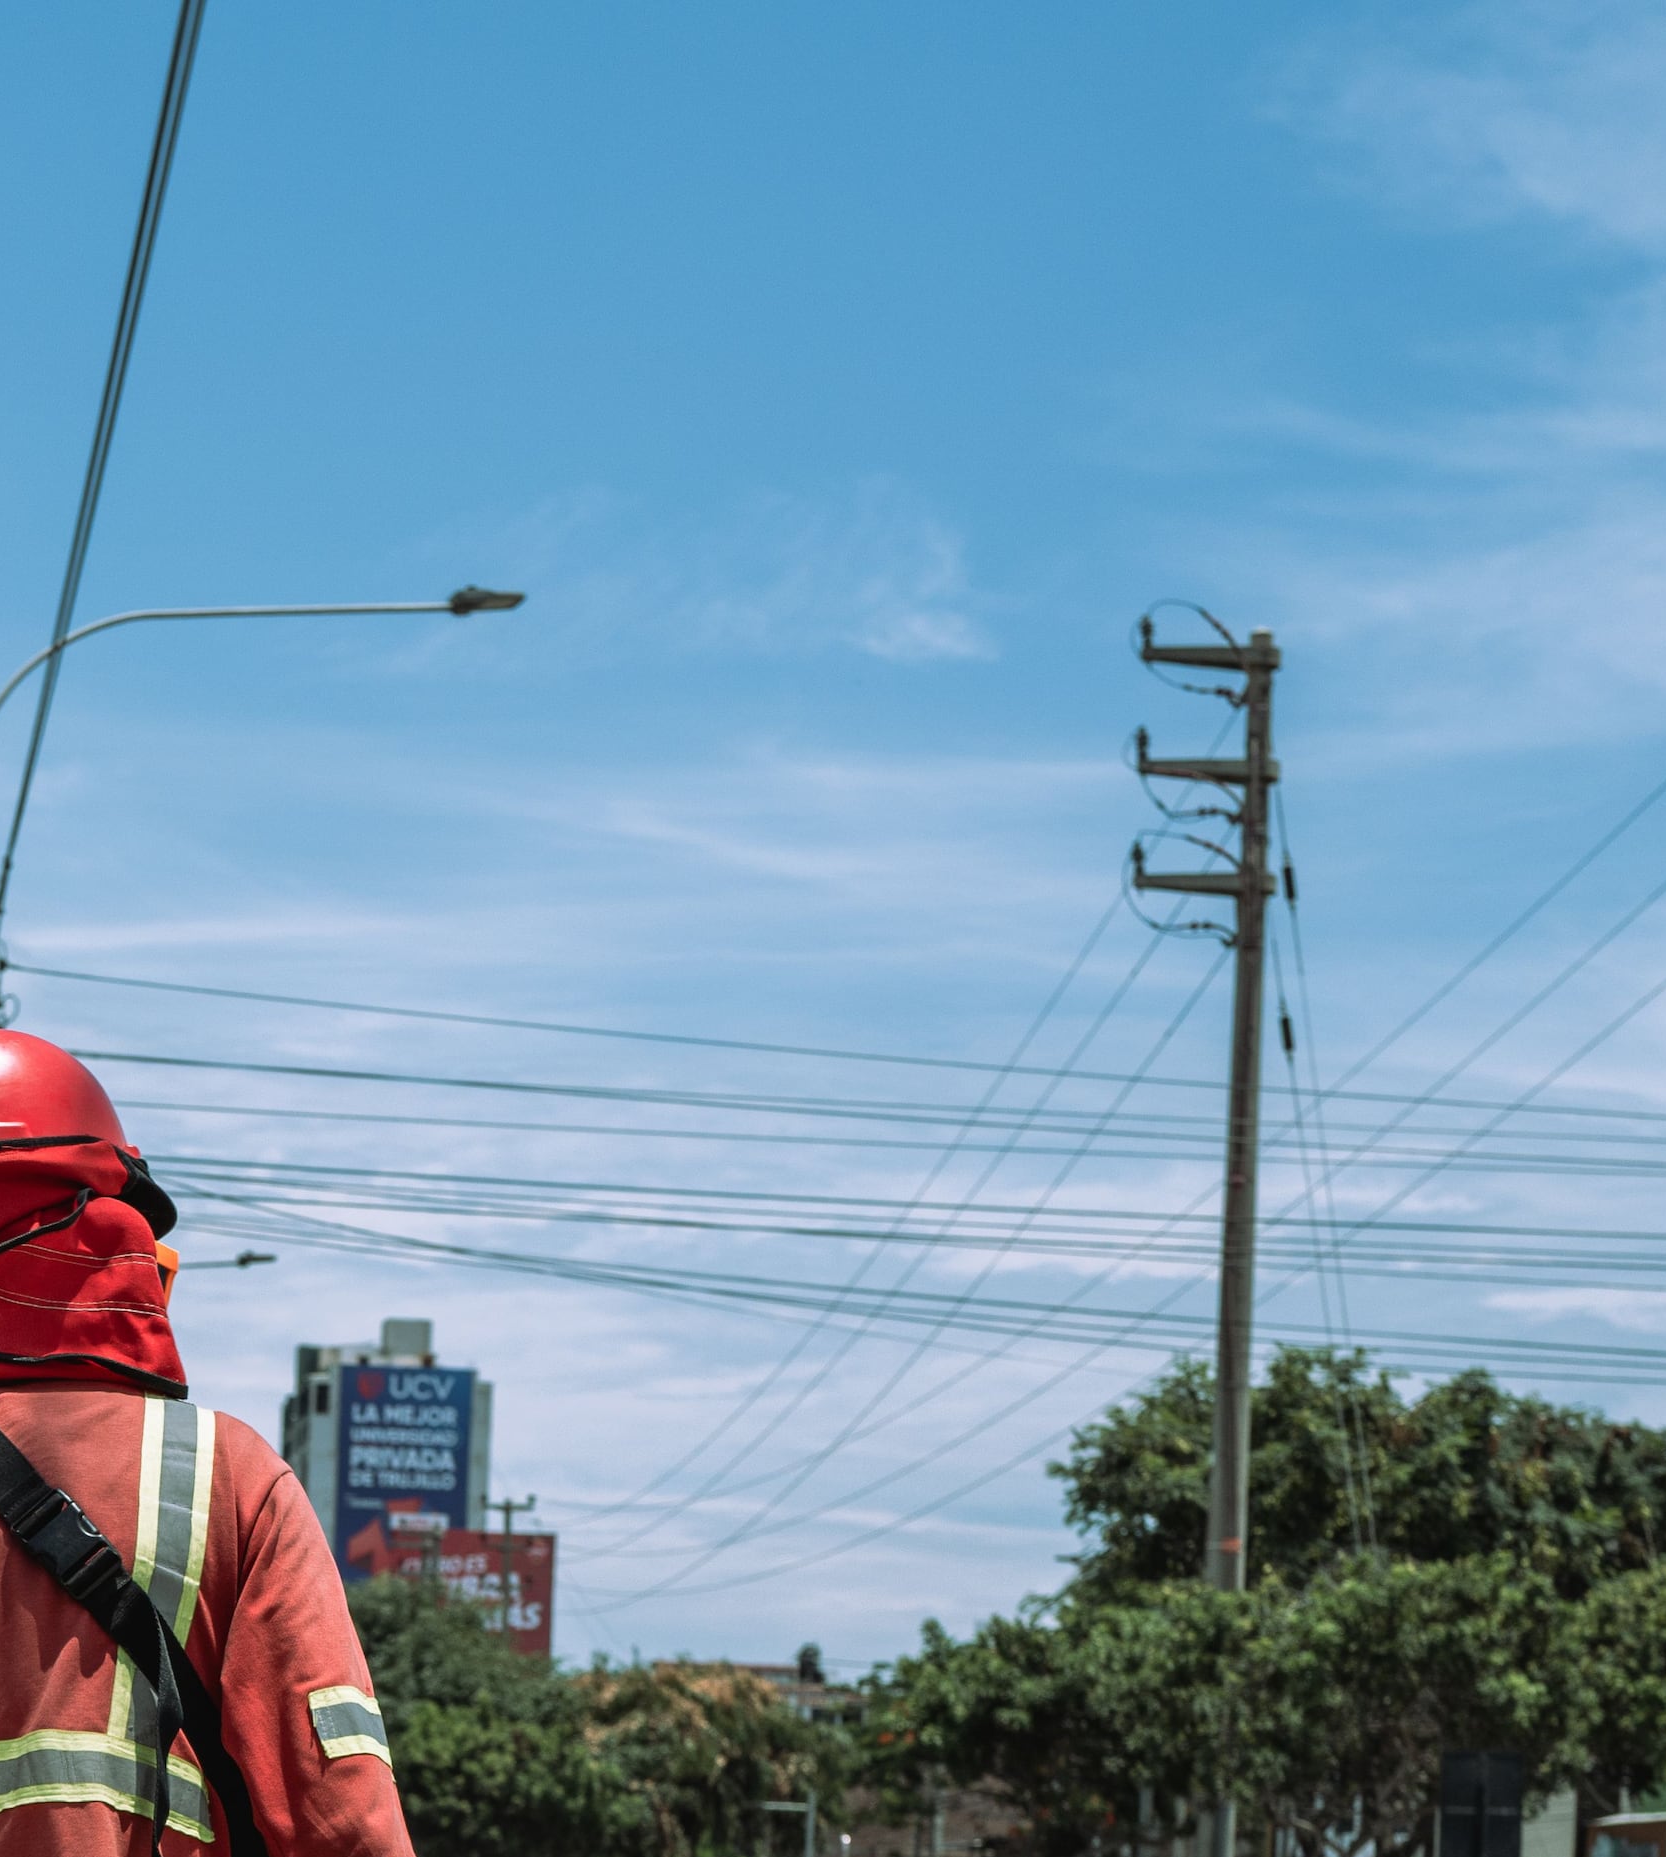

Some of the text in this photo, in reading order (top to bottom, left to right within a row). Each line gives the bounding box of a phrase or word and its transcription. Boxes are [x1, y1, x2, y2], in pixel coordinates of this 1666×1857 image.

[389, 1374, 454, 1399] UCV
[351, 1403, 458, 1427] LA MEJOR
[349, 1427, 458, 1447] UNIVERSIDAD
[349, 1446, 455, 1470] PRIVADA
[348, 1469, 456, 1491] DE TRUJILLO
